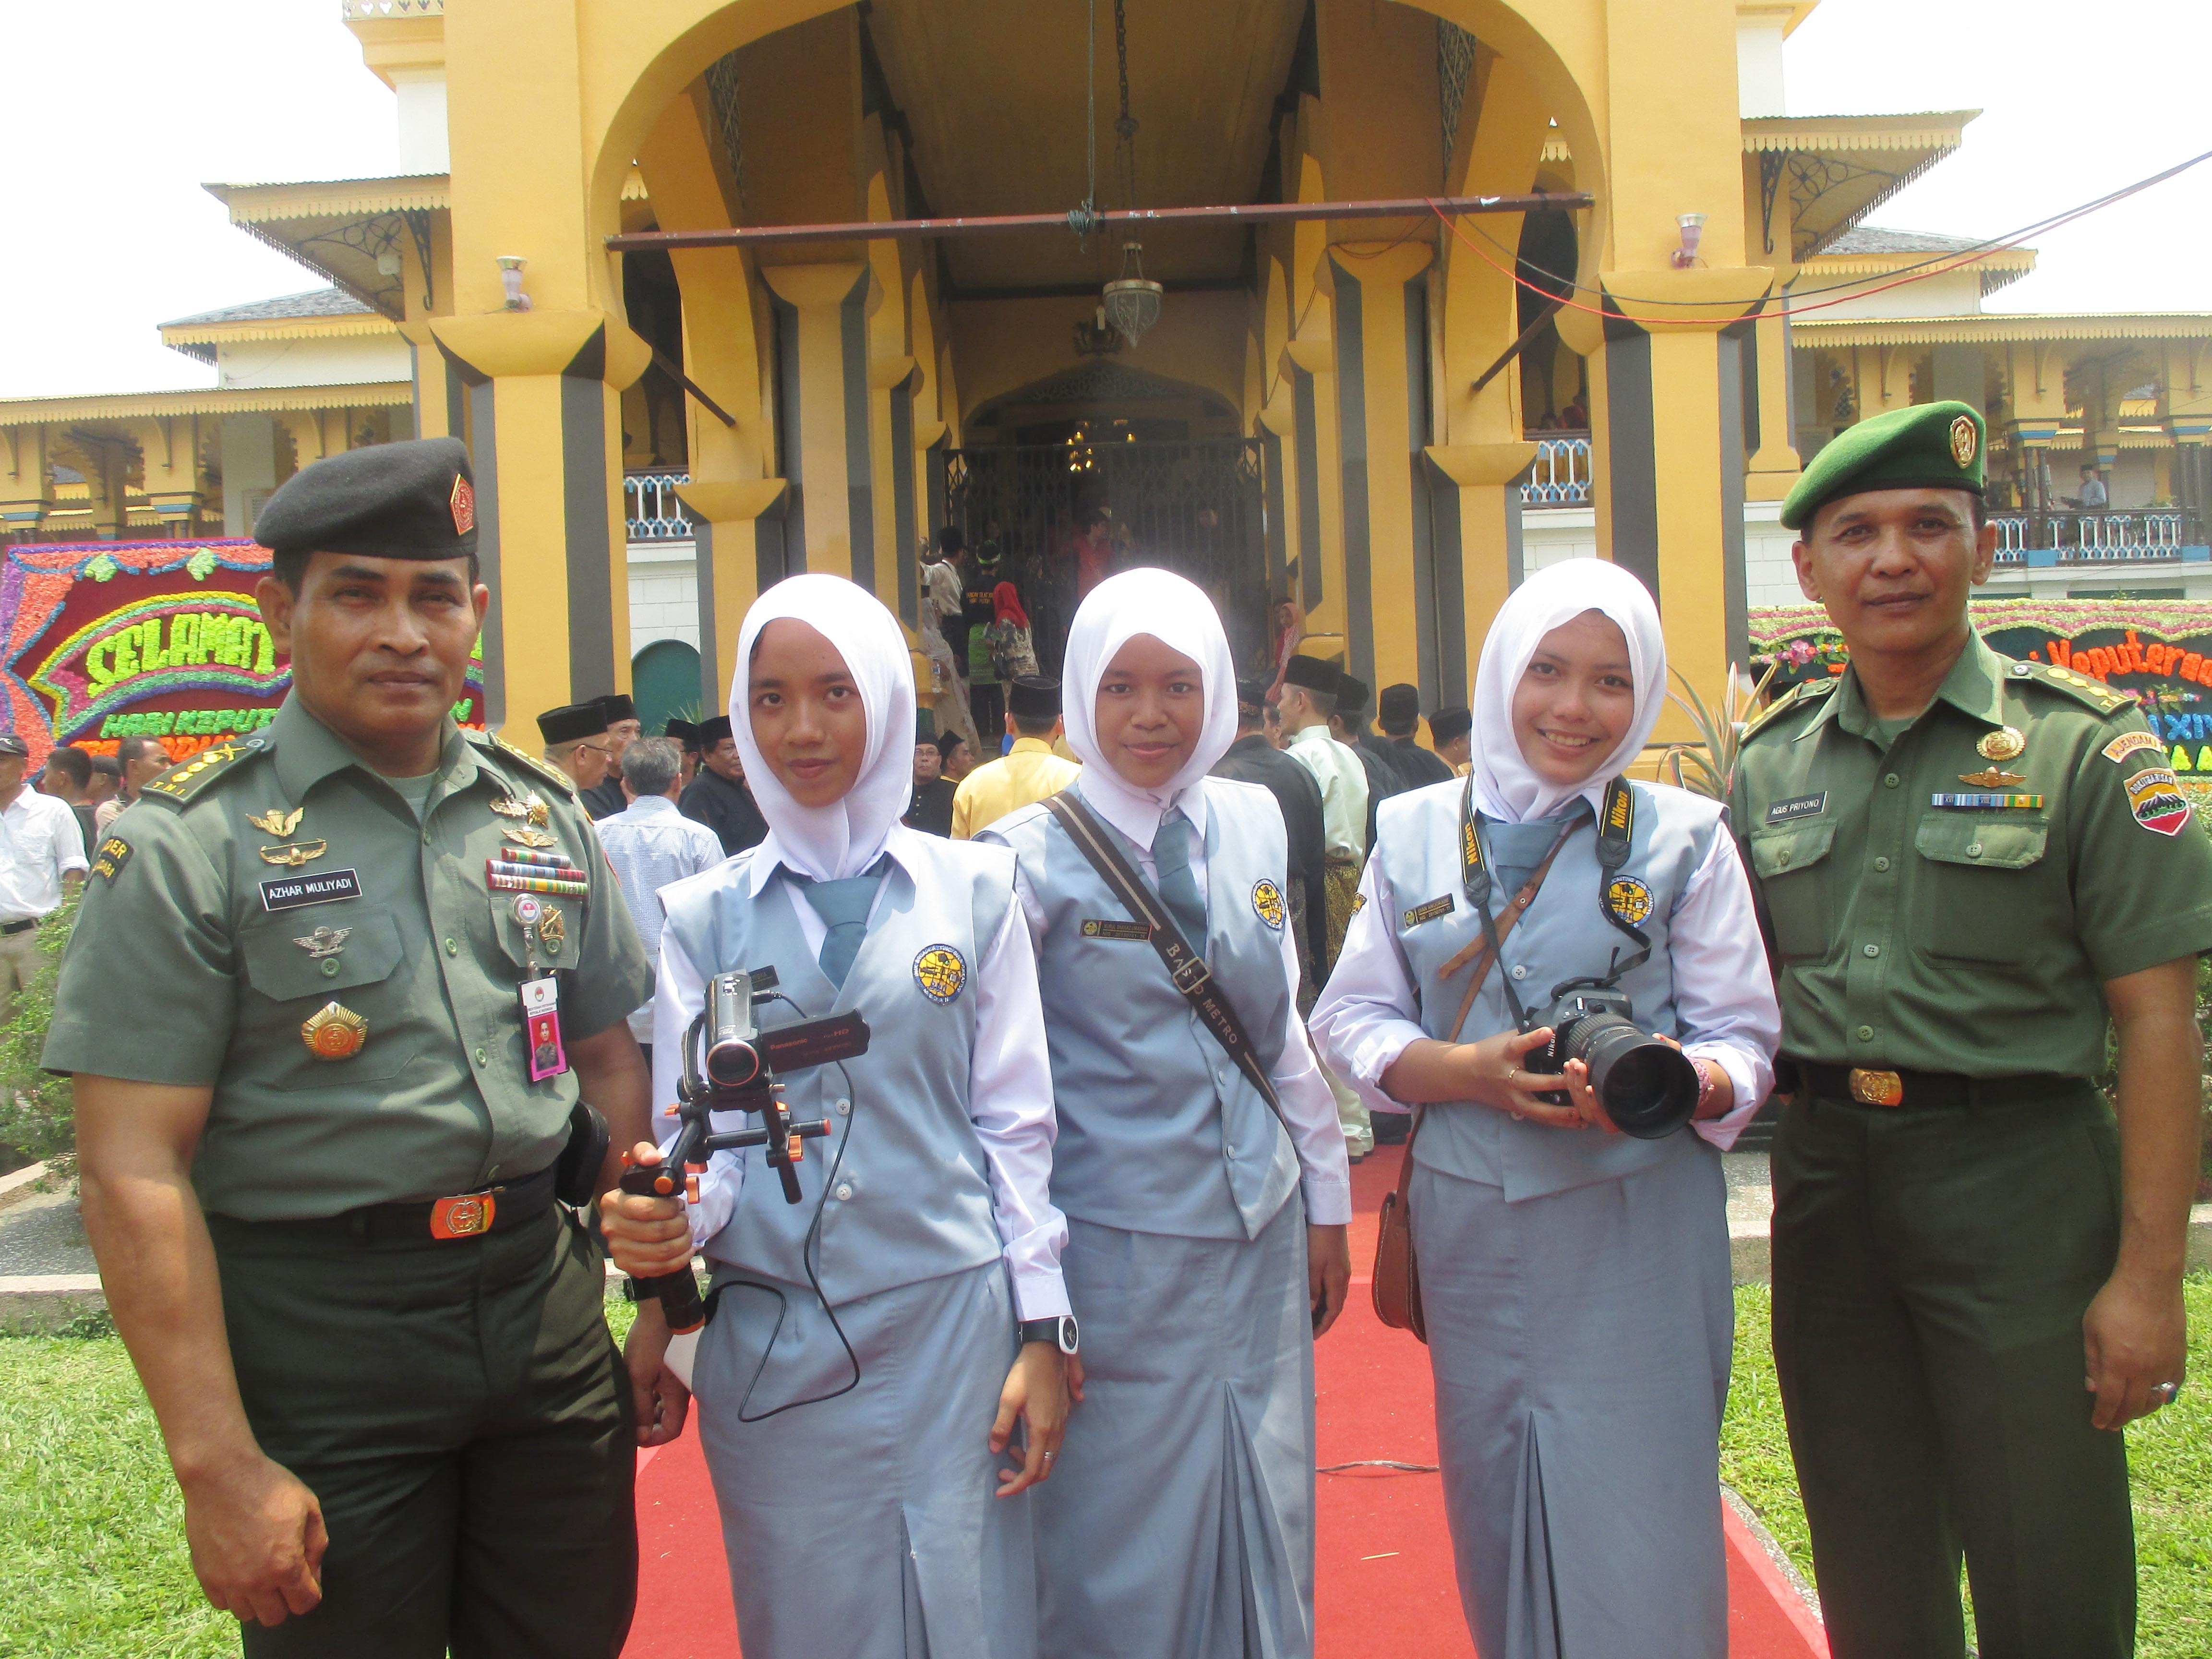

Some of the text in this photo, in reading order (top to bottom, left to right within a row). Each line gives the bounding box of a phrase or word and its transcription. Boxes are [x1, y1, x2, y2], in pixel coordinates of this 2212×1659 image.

[86, 612, 276, 699] SELAMAT
[100, 708, 280, 739] HARI KEPUT
[153, 781, 186, 795] TNI
[1610, 790, 1628, 829] Nikon
[1771, 799, 1819, 816] AGUS PRIYONO
[1465, 822, 1478, 865] Nikon
[269, 878, 352, 899] AZHAR MULIYADI
[1202, 998, 1238, 1045] METRO
[770, 1038, 808, 1050] Panasonic
